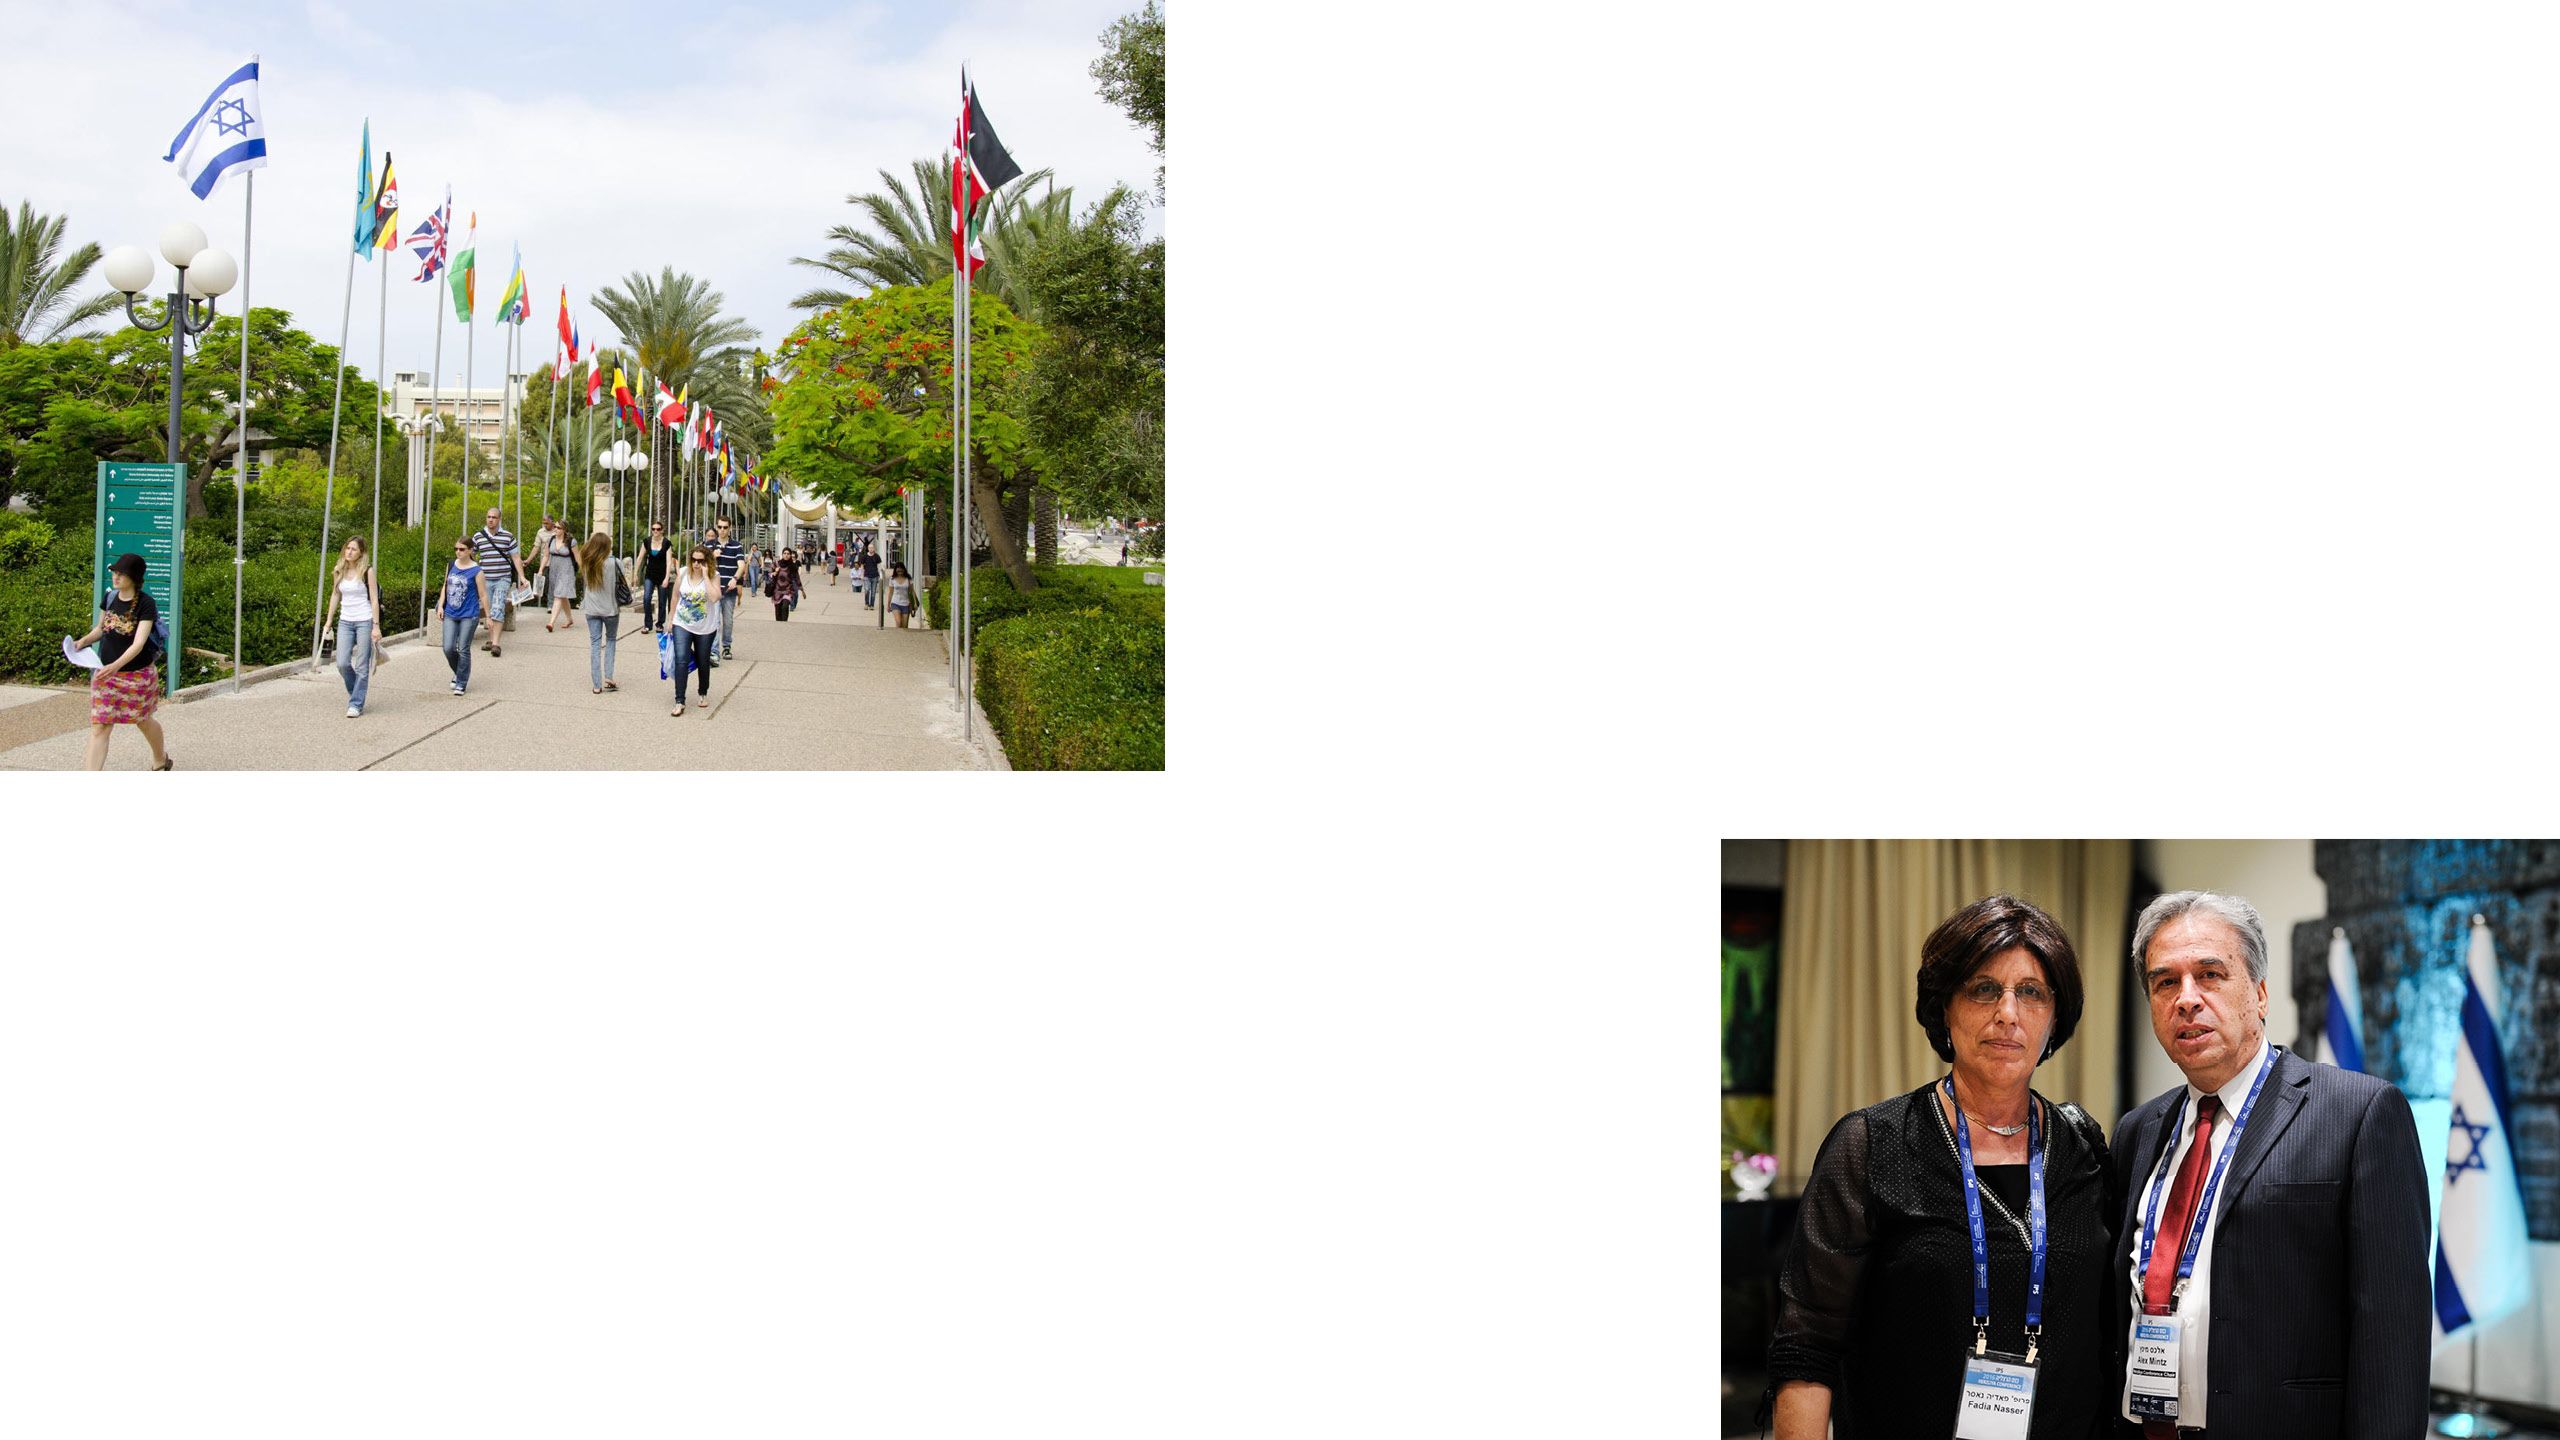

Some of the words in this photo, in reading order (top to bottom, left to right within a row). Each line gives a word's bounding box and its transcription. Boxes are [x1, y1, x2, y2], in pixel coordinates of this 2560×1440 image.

[2137, 1356, 2148, 1364] Alex
[2149, 1357, 2167, 1367] Mintz
[1966, 1390, 1984, 1399] נאסר
[1986, 1393, 2009, 1402] פאדיה
[1968, 1401, 1991, 1411] Fadia
[1994, 1404, 2024, 1415] Nasser
